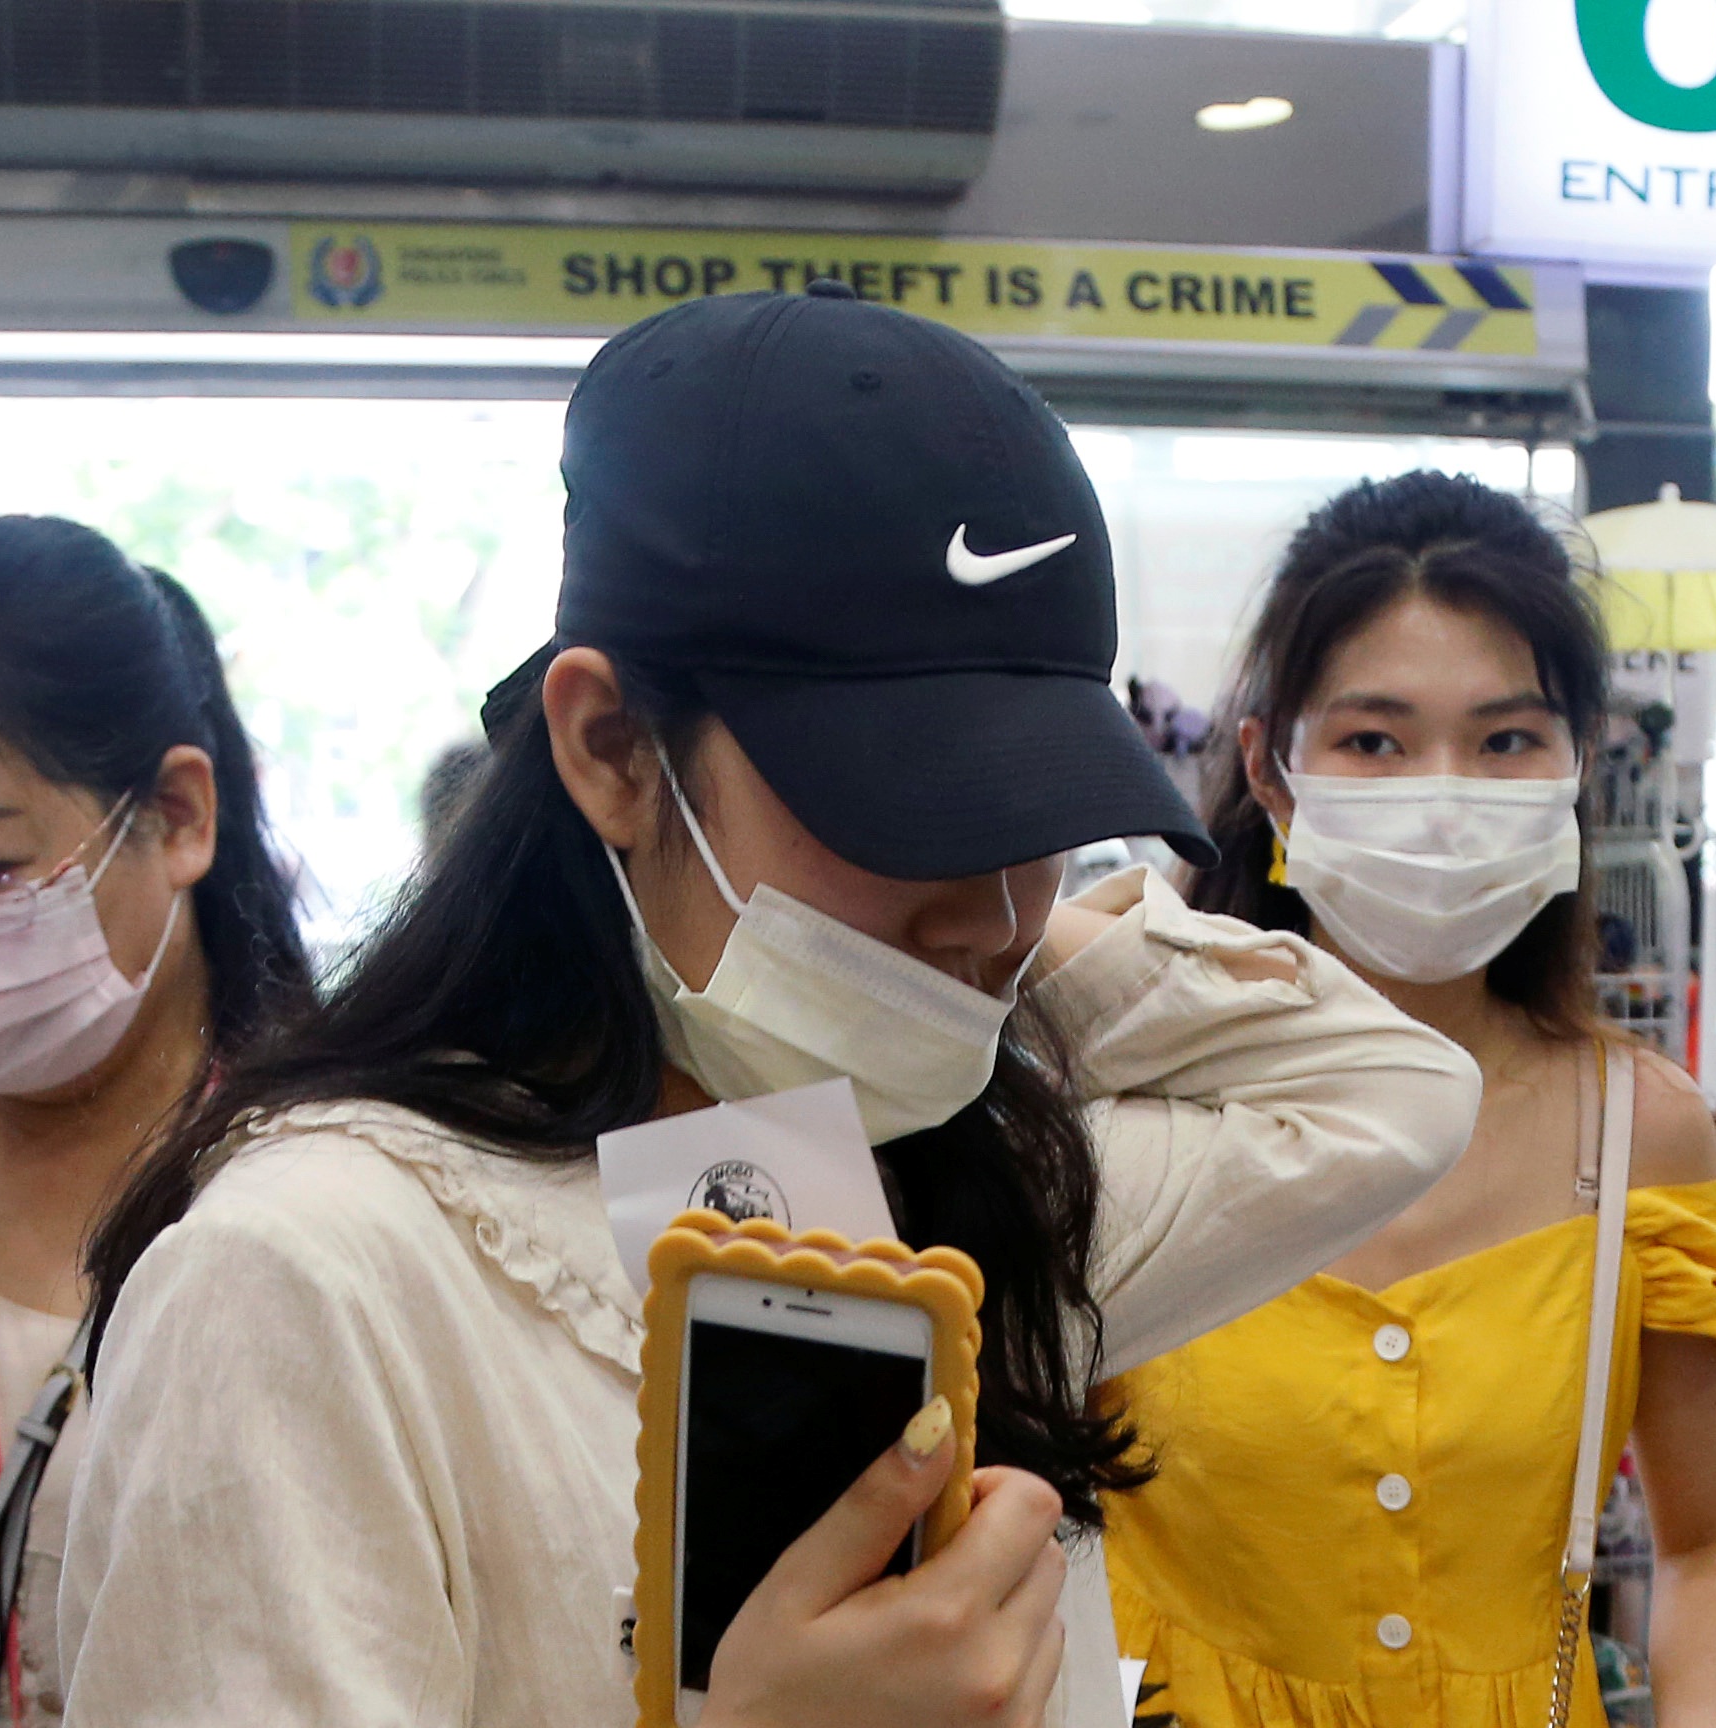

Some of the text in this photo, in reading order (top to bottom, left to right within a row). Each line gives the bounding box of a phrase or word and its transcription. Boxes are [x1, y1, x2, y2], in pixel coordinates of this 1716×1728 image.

[562, 254, 1316, 318] SHOP THEFT IS A CRIME
